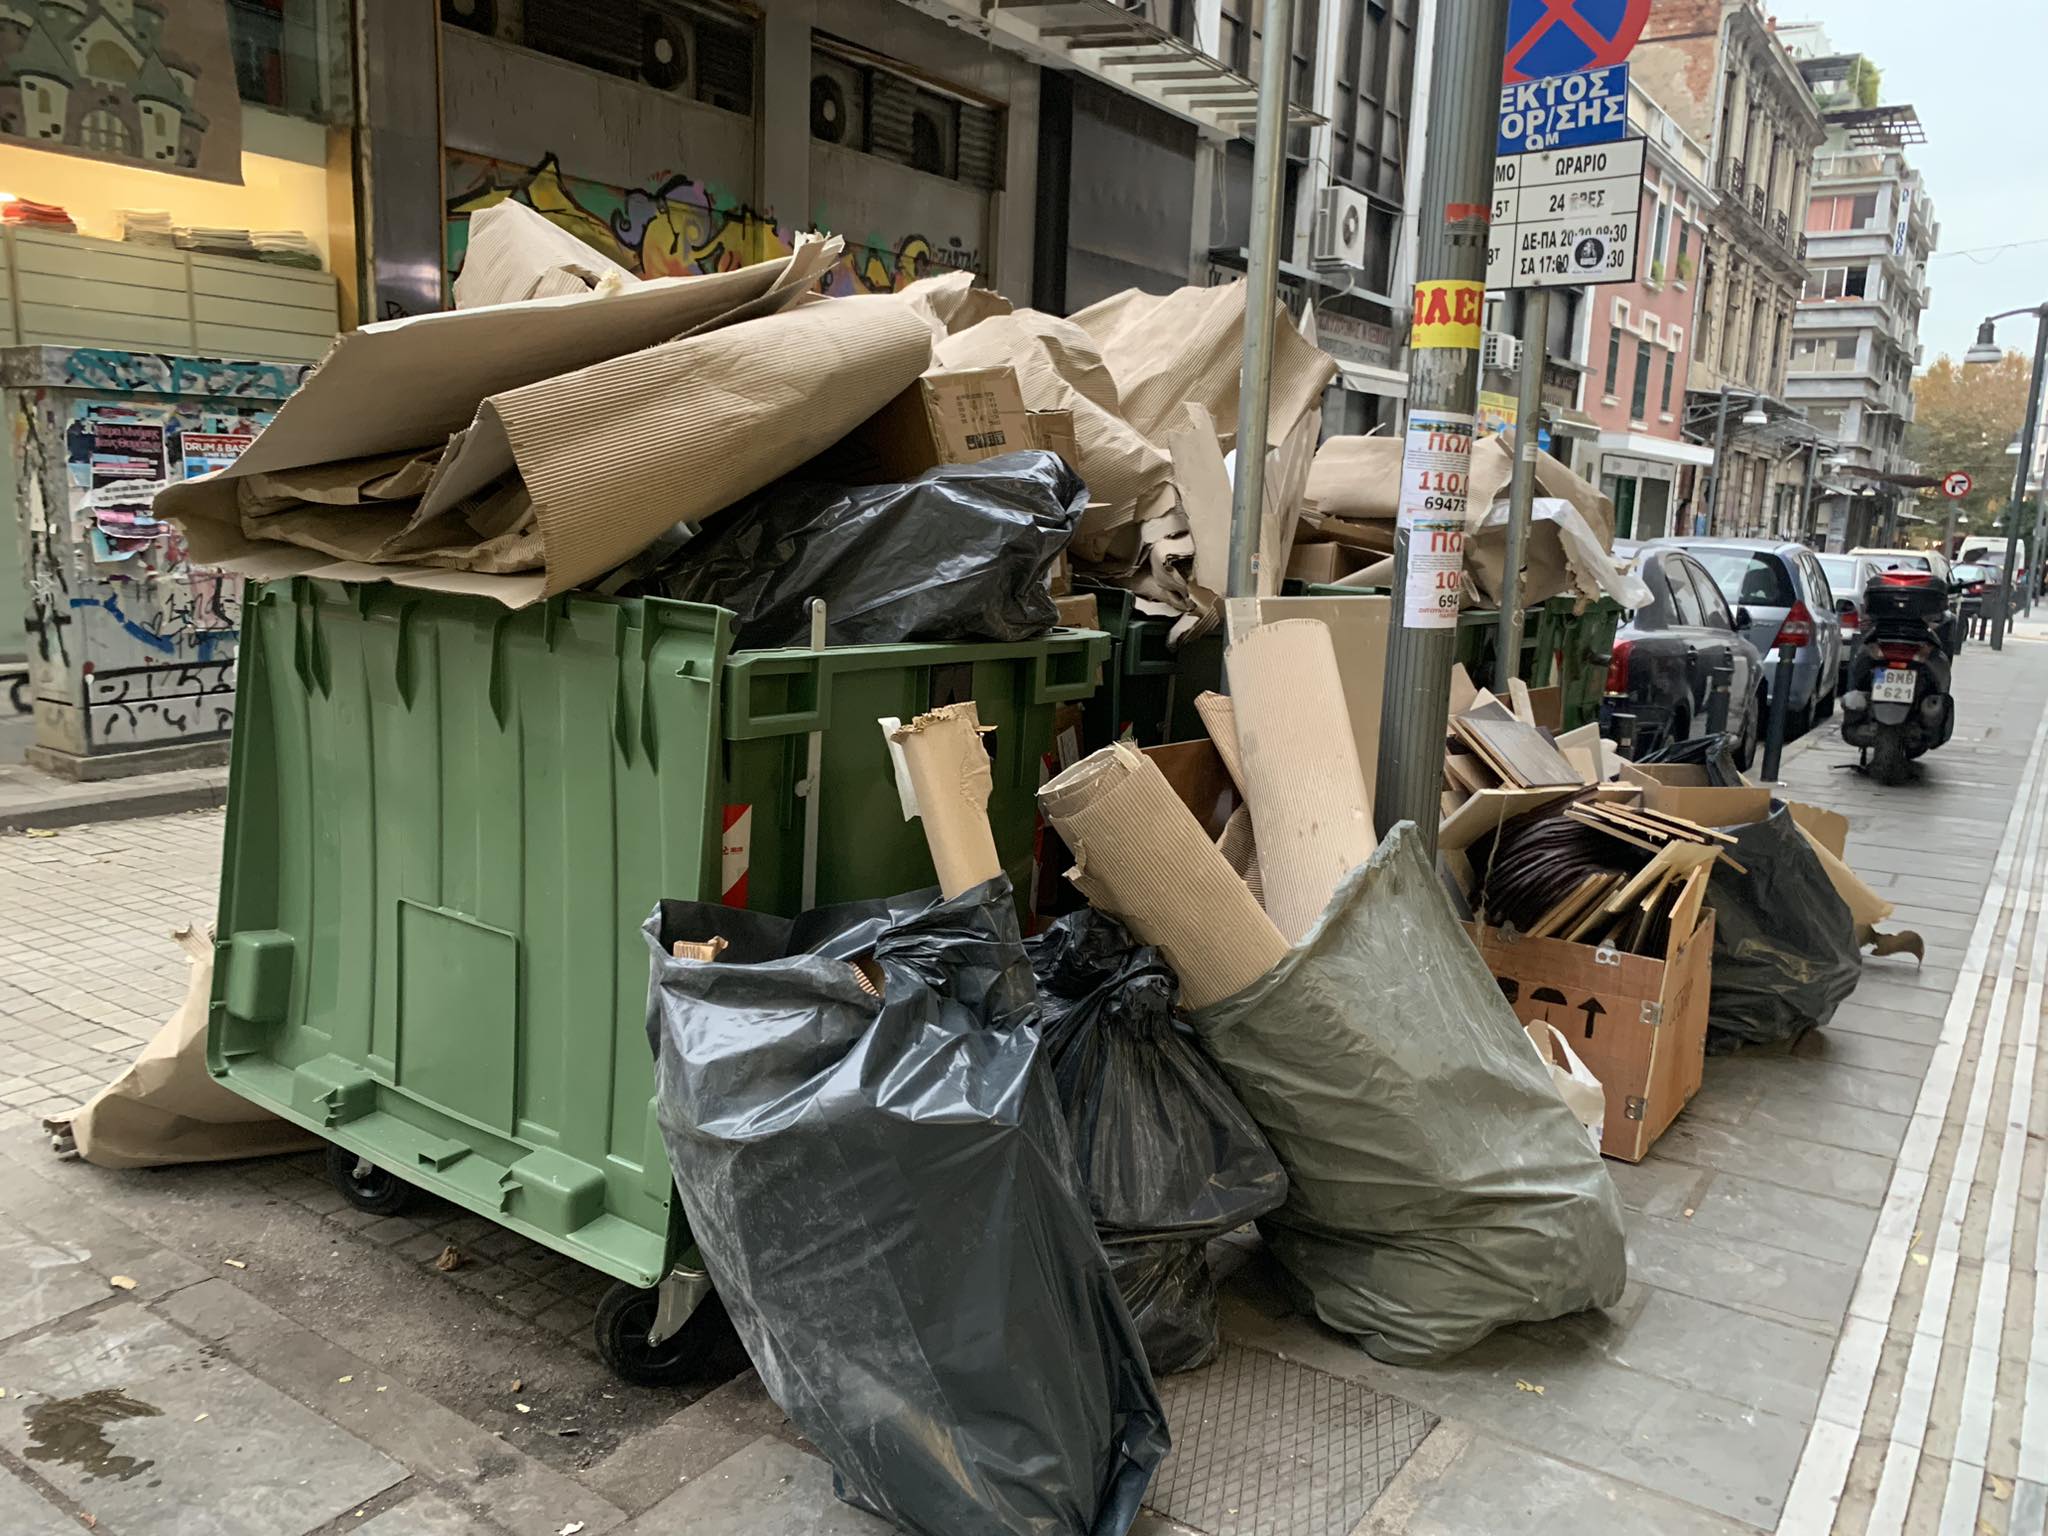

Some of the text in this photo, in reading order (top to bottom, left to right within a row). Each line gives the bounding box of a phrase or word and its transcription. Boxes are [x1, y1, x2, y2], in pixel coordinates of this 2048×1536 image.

[1500, 70, 1609, 114] ΕΚΤΟΣ
[1555, 153, 1607, 176] ΩΡΑΡΙΟ
[1549, 194, 1565, 212] 24
[1522, 231, 1557, 251] ΔΕ-ΠΑ
[1520, 257, 1535, 275] ΣΑ
[184, 442, 214, 451] DRUM
[1884, 687, 1913, 699] 621
